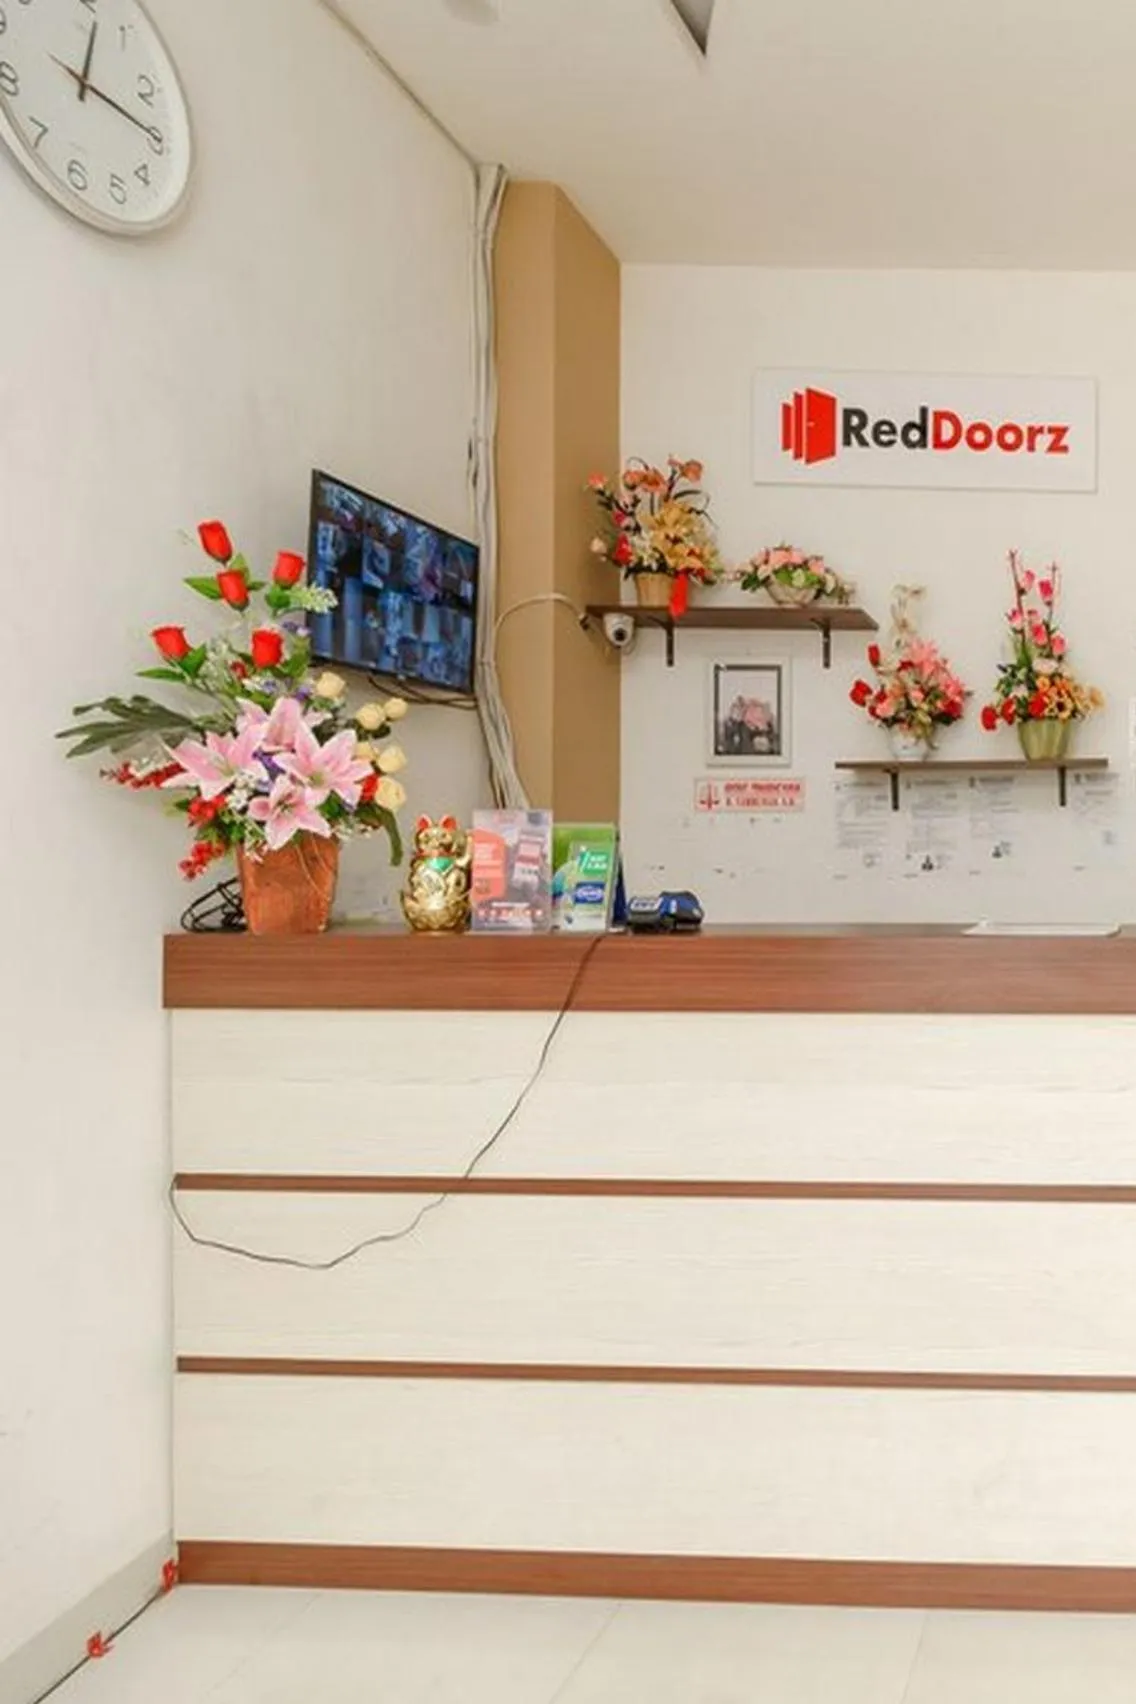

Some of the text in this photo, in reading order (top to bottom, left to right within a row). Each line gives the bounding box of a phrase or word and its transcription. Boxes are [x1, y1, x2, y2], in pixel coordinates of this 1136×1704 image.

[137, 74, 155, 107] 2
[28, 115, 48, 149] 7
[67, 159, 87, 191] 6
[109, 173, 127, 205] 5
[133, 163, 151, 187] 4
[842, 405, 1071, 454] RedDoorz
